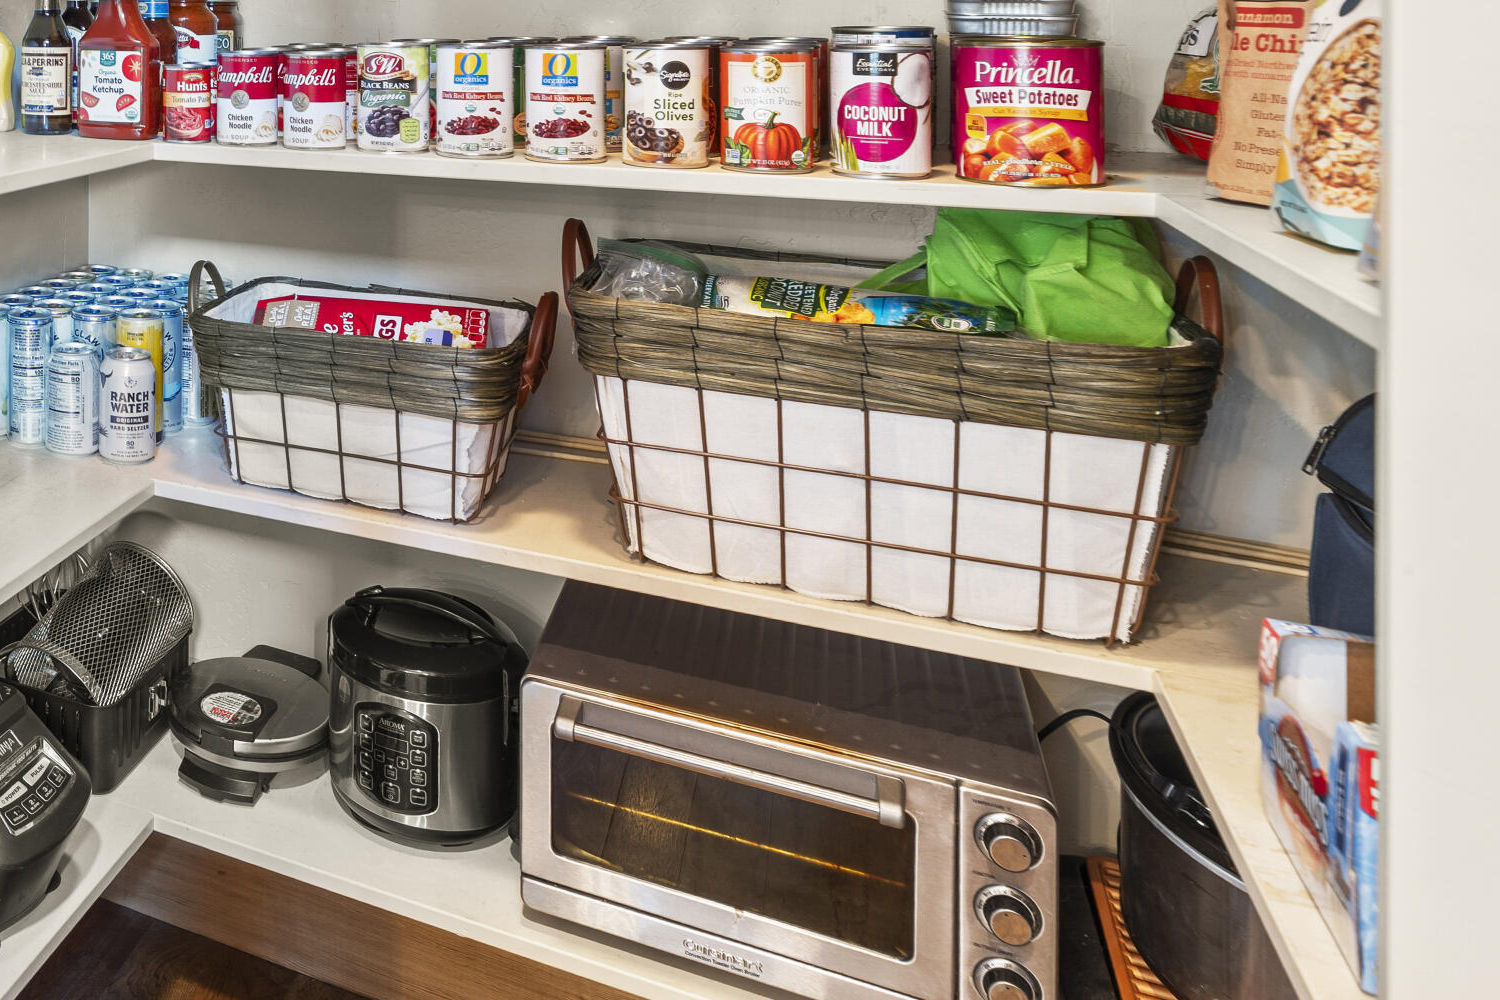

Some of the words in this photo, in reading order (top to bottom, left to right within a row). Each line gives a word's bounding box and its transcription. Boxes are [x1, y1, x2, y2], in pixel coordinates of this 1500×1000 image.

[100, 53, 115, 62] 365
[974, 60, 1075, 84] Princella
[94, 76, 123, 85] Tomato
[360, 81, 381, 89] BLACK
[382, 81, 410, 90] BEANS
[543, 77, 577, 86] organics
[92, 84, 125, 95] Ketchup
[177, 82, 208, 92] Hunt's
[171, 95, 197, 103] Tomato
[361, 89, 407, 106] Organic
[454, 92, 465, 100] Red
[466, 93, 487, 101] Kidney
[542, 93, 553, 101] Red
[554, 94, 575, 102] Kidney
[576, 94, 595, 102] Beans
[733, 96, 777, 106] Pumpkin
[975, 89, 1014, 104] Sweet
[1018, 89, 1079, 107] Potatoes
[653, 98, 695, 110] Sliced
[228, 113, 253, 122] Chicken
[655, 111, 694, 121] Olives
[844, 104, 907, 122] COCONUT
[228, 122, 252, 130] Noodle
[289, 116, 313, 125] Chicken
[289, 125, 313, 133] Noodle
[856, 121, 893, 137] MILK
[1232, 141, 1247, 152] No
[275, 302, 287, 327] REAL
[301, 303, 314, 327] REAL
[74, 328, 100, 347] CLAW
[110, 391, 149, 402] RANCH
[110, 401, 149, 414] WATER
[380, 717, 405, 731] AROMA
[30, 764, 46, 778] PULSE
[4, 785, 22, 801] POWER
[682, 938, 764, 974] Cuisinart
[684, 950, 712, 963] Convection
[712, 958, 729, 969] Toaster
